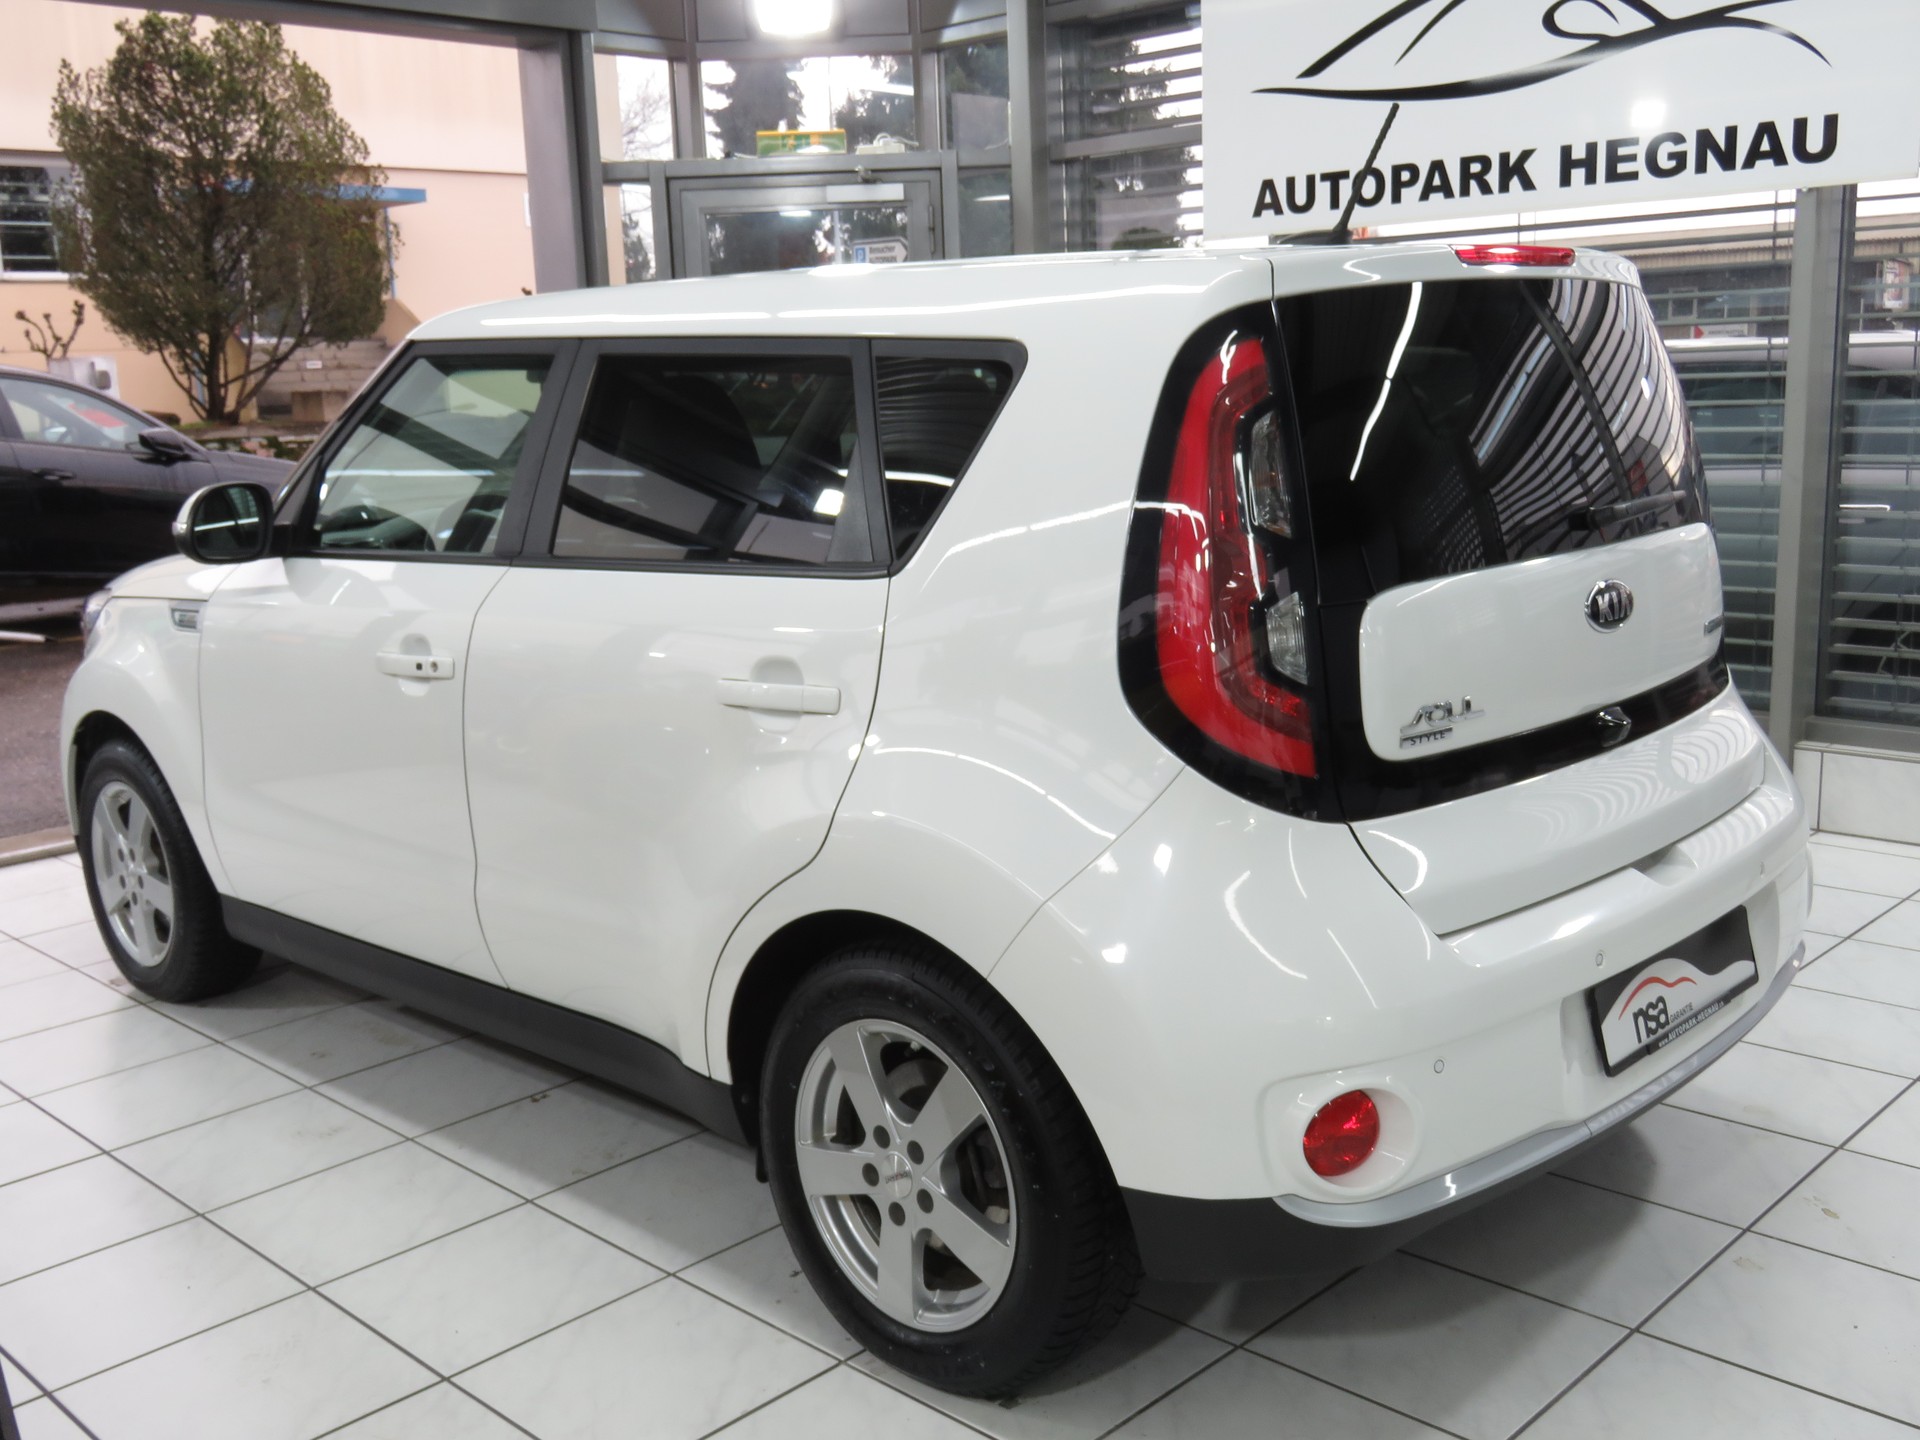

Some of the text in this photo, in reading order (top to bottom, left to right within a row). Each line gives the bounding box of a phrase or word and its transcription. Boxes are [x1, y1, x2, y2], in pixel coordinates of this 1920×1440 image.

[1252, 113, 1840, 218] AUTOPARK HEGNAU
[1595, 587, 1632, 623] KIA
[1410, 730, 1446, 746] STYLE
[1632, 995, 1670, 1044] nsa
